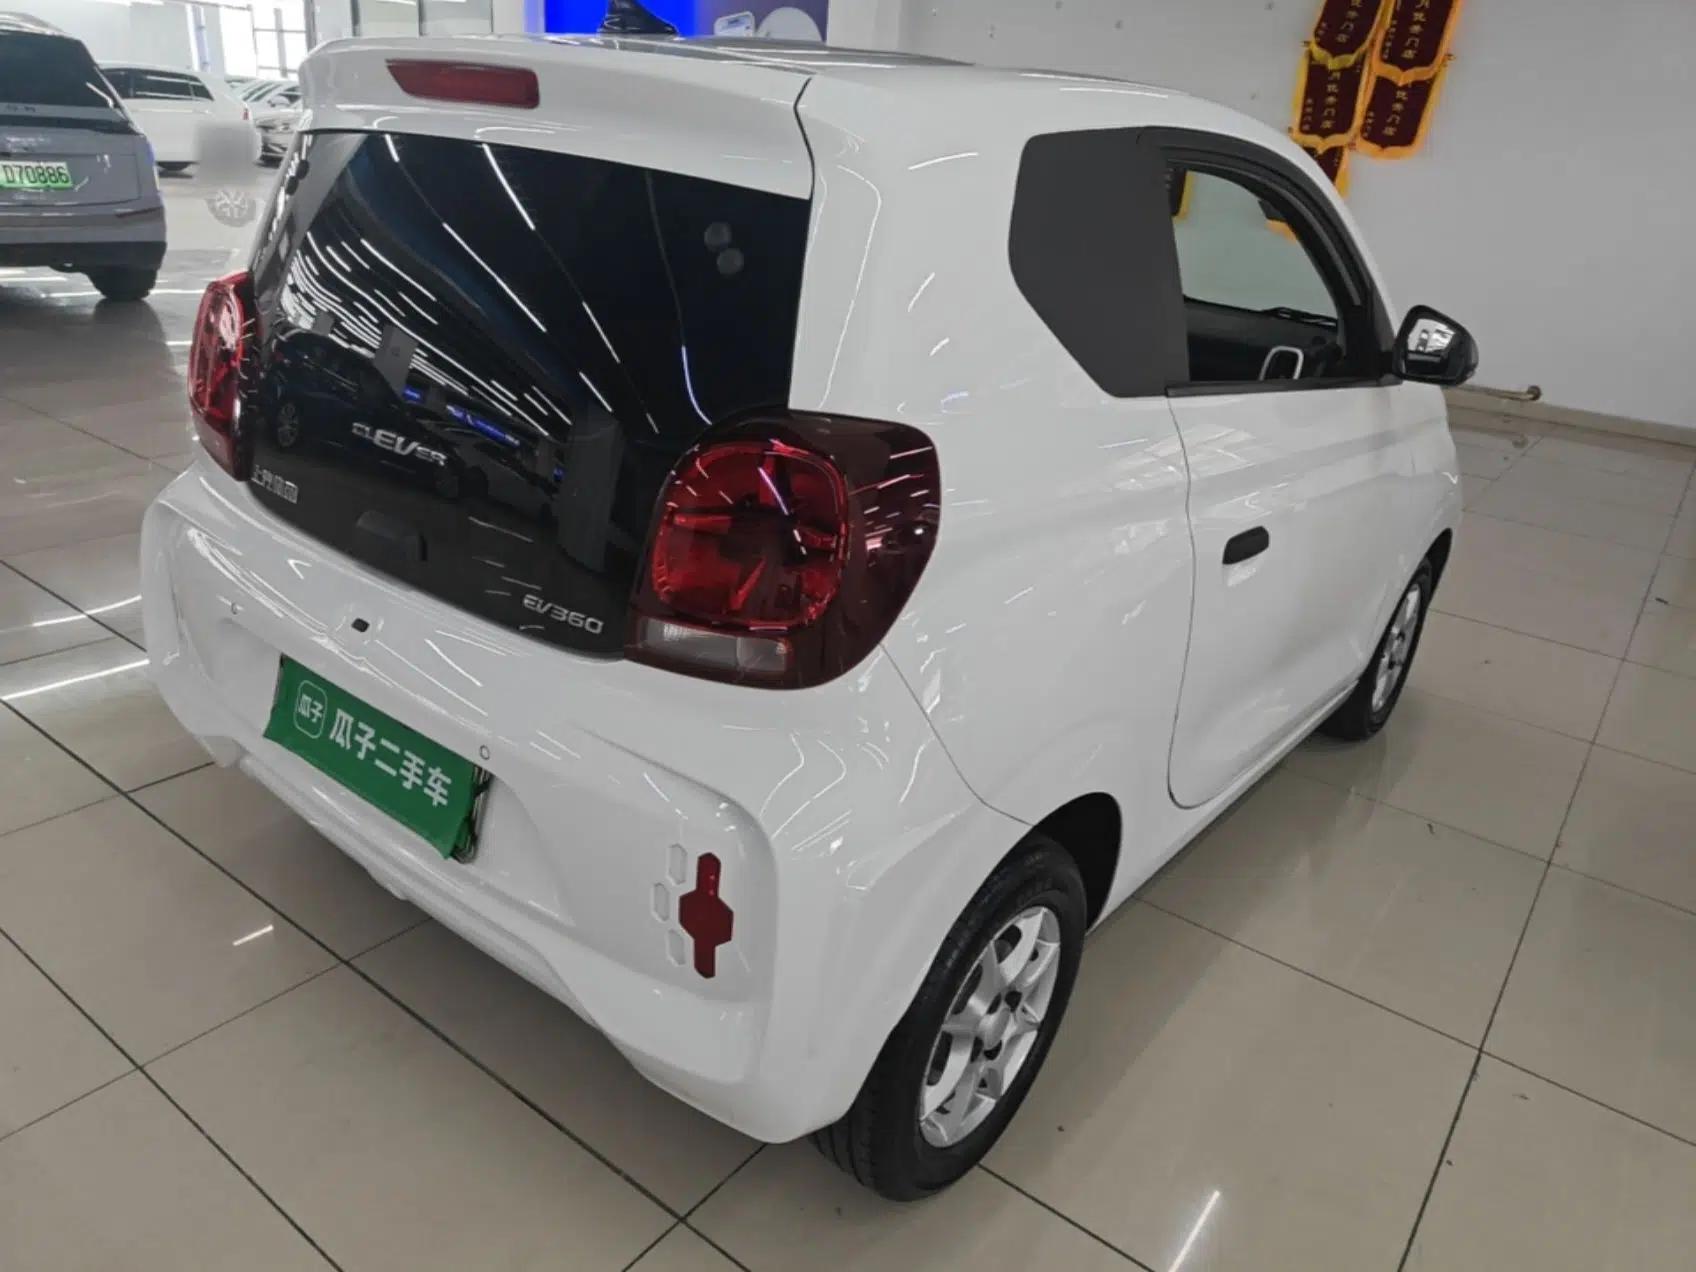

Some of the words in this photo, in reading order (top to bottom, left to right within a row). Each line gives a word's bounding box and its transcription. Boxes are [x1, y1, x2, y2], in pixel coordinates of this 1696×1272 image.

[2, 164, 70, 185] D70886
[523, 594, 604, 634] EV360
[297, 694, 324, 723] 瓜子
[329, 708, 452, 808] 瓜子二手车
